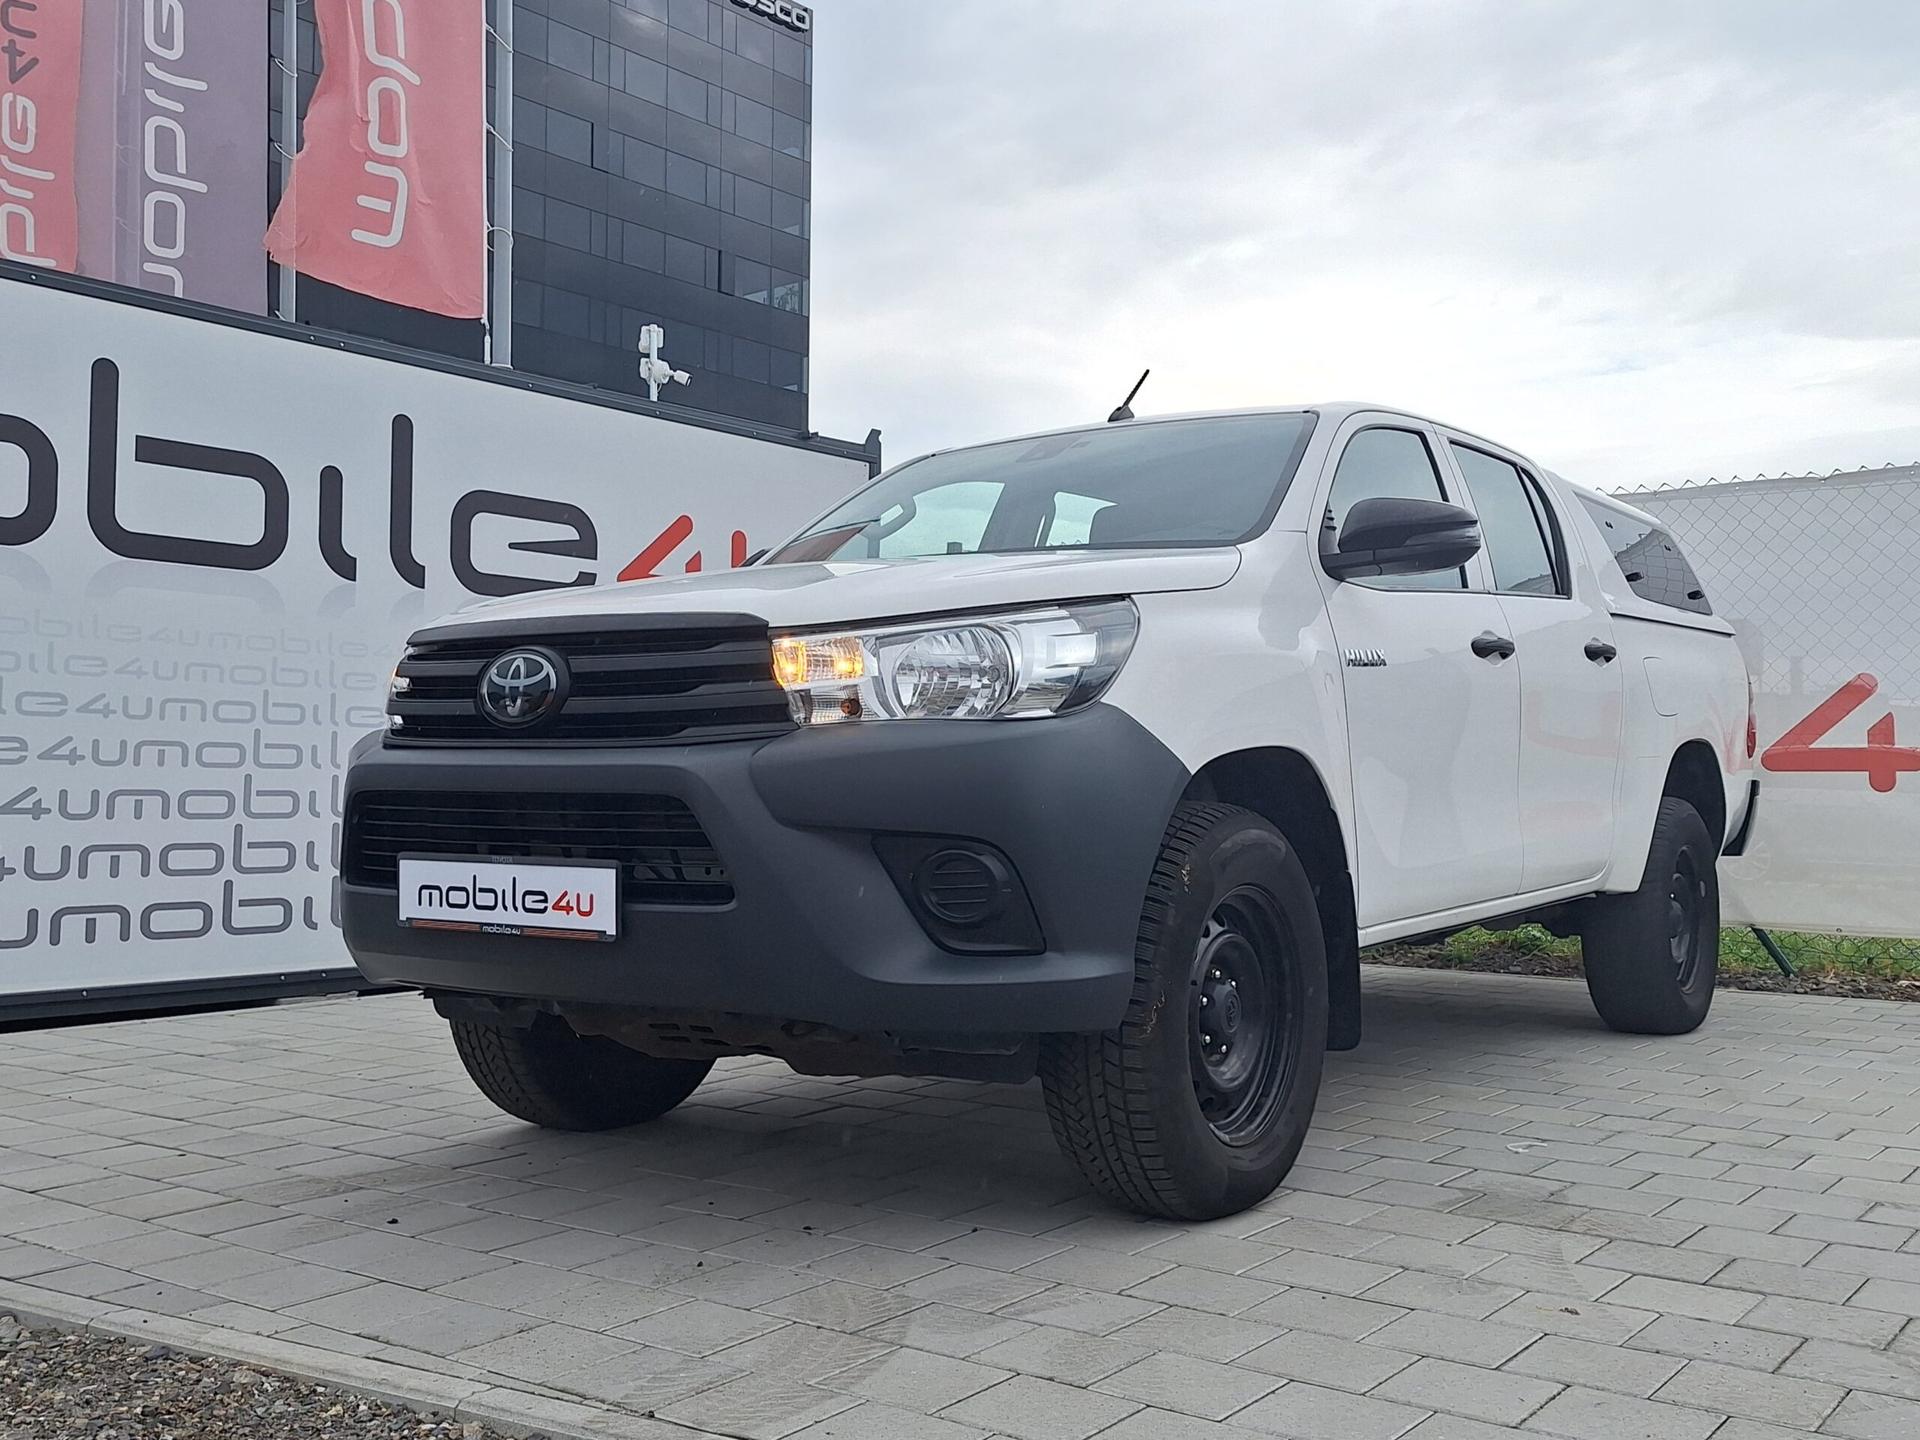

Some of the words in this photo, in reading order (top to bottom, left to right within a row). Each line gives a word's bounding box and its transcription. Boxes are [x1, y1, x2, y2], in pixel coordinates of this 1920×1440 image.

[742, 0, 810, 30] SCO
[0, 358, 747, 598] bile4
[1343, 648, 1387, 667] HILUX
[0, 822, 341, 882] umobil
